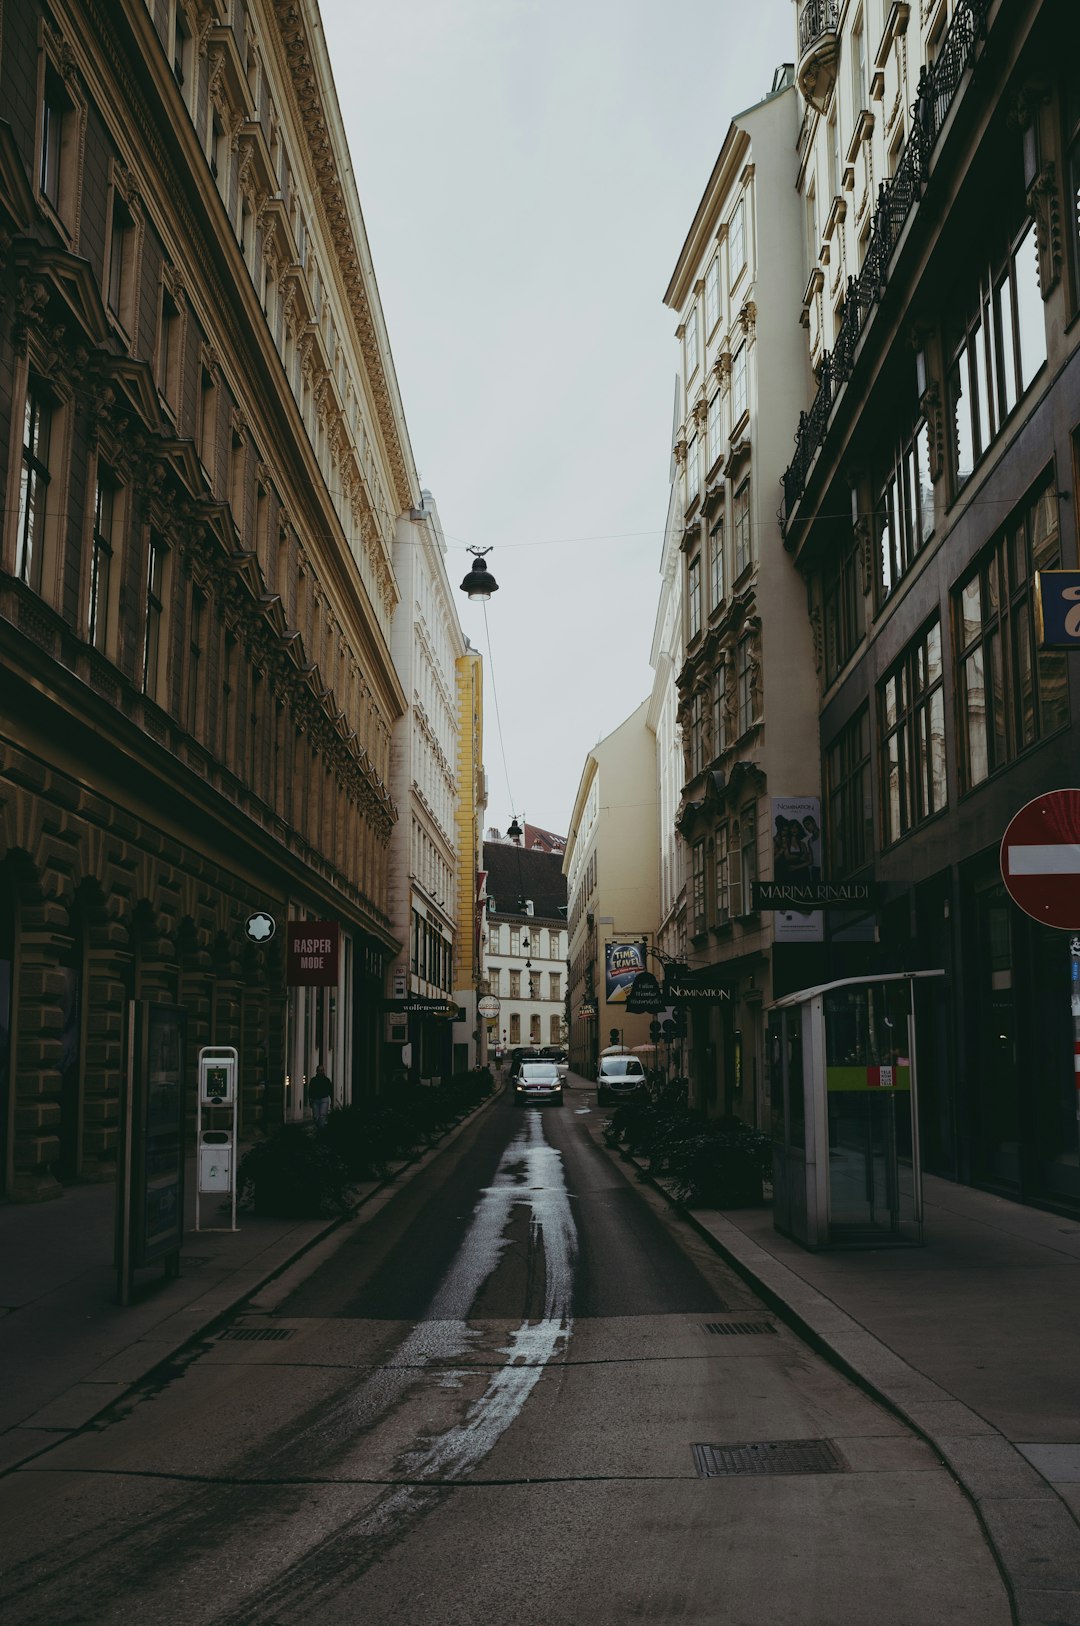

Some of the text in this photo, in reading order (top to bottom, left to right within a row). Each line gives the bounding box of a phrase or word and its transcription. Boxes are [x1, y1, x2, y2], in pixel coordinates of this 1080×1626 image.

[759, 885, 869, 900] MARINA RINALDI
[293, 938, 332, 954] RASPER
[615, 950, 635, 960] TIME
[300, 956, 325, 969] MODE
[612, 957, 640, 968] TRAVEL
[669, 985, 730, 1000] NOMINATION
